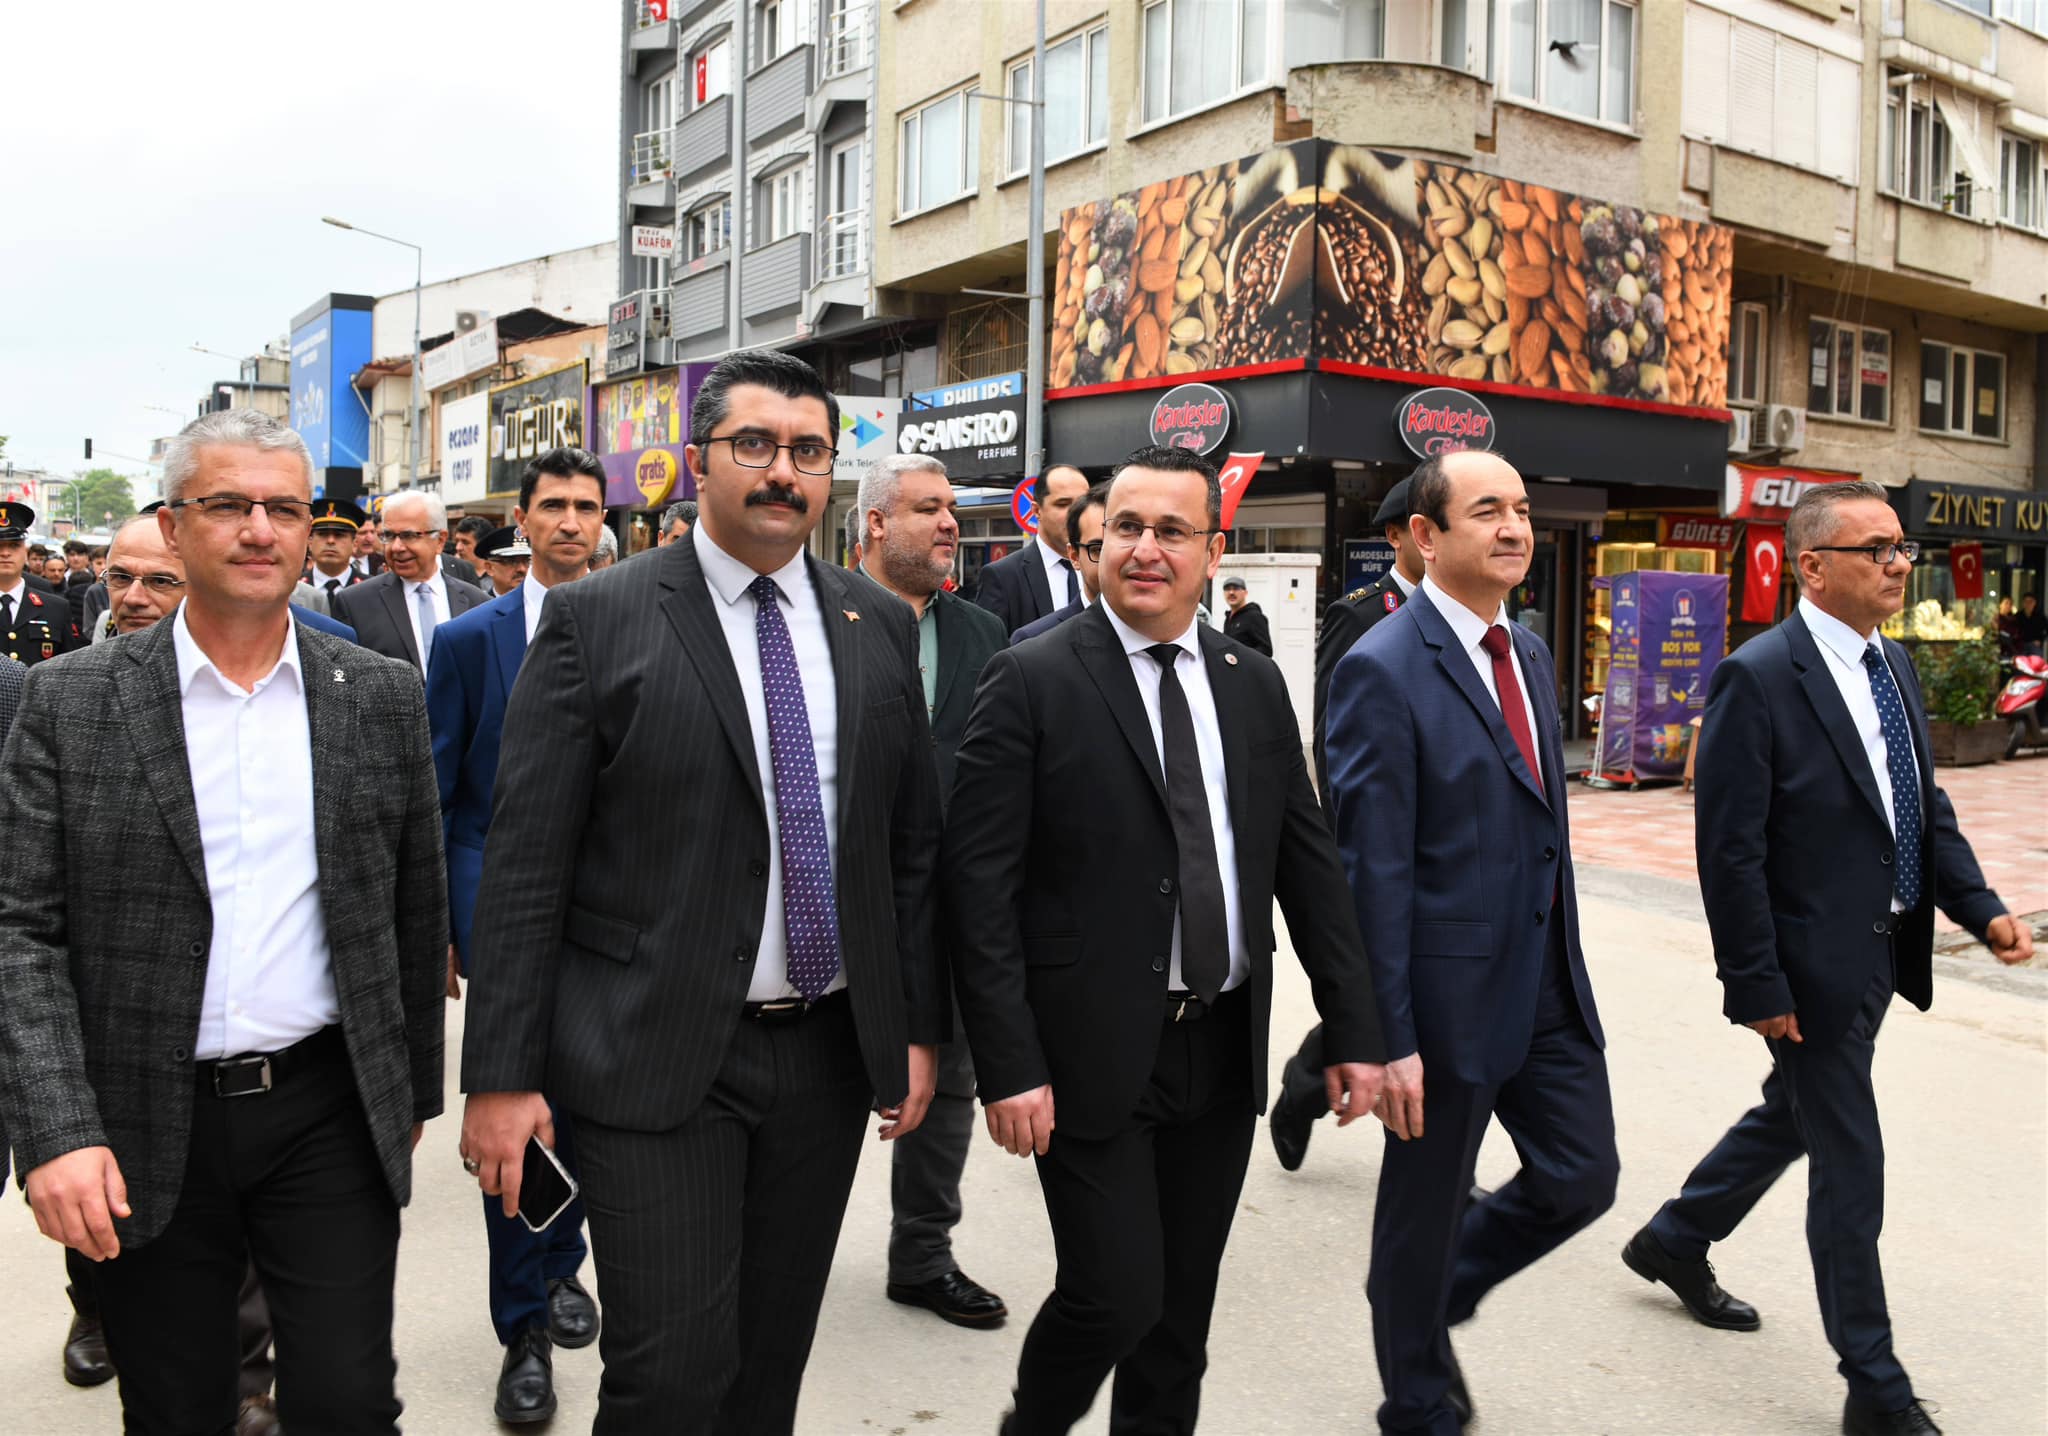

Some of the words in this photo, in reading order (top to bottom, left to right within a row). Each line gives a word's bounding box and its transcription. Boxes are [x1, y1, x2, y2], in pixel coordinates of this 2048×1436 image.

[638, 235, 672, 248] KUAFÖR
[1154, 399, 1224, 433] Kardeşler
[1406, 402, 1489, 437] Kardeşler
[977, 445, 1018, 460] PERFUME
[640, 455, 666, 487] gratis
[1926, 485, 2006, 528] ZİYNET
[1671, 520, 1733, 546] GÜNEŞ
[1350, 550, 1395, 560] KARDEŞLER
[1361, 560, 1383, 572] BÜFE
